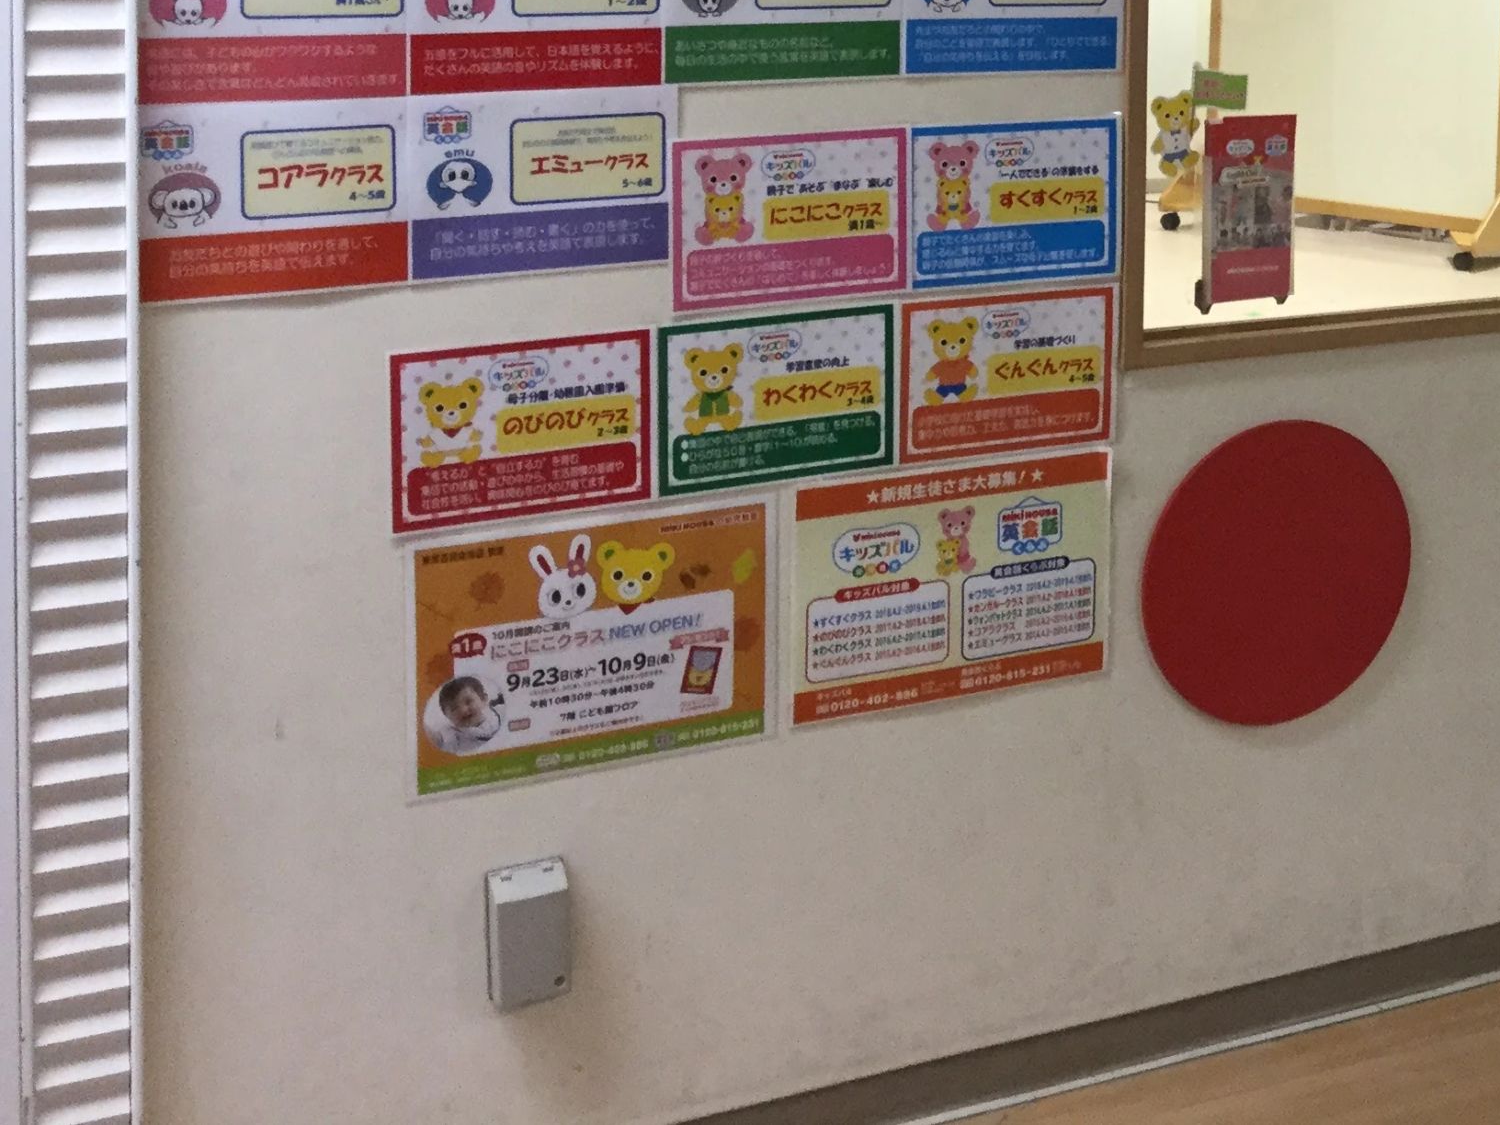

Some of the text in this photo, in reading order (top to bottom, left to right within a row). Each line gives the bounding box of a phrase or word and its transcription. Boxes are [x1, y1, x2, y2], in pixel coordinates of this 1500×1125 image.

[444, 148, 476, 159] emu
[530, 153, 650, 175] エミュークラス
[258, 163, 384, 189] コアラクラス
[1000, 187, 1097, 209] すくすくクラス
[770, 202, 882, 225] にこにこクラス
[995, 358, 1094, 381] ぐんぐんクラス
[764, 381, 872, 406] わくわくクラス
[503, 408, 630, 436] のびのびクラス
[840, 542, 915, 562] キッズパル
[491, 613, 704, 660] にこにこクラス NEW OPEN!
